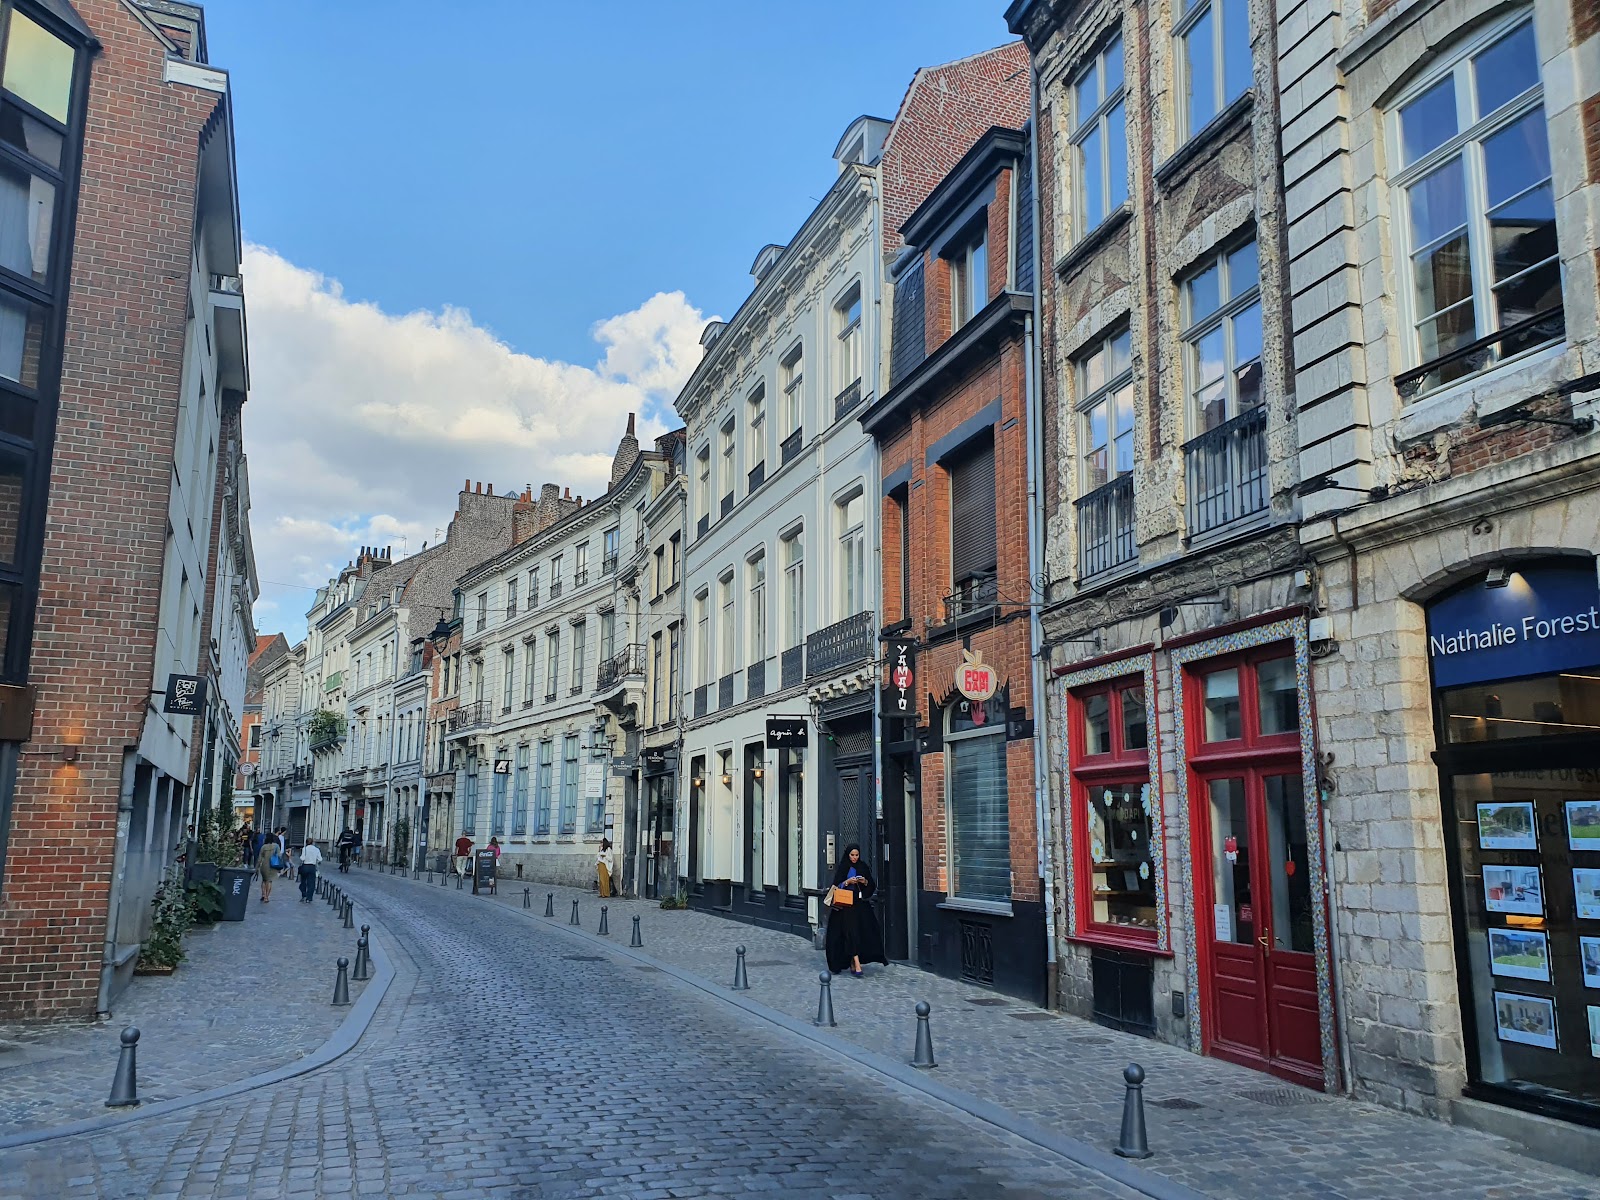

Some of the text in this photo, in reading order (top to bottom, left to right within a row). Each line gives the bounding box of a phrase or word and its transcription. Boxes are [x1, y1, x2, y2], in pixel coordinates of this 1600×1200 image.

[1430, 606, 1600, 656] Nathalie Forest
[896, 645, 909, 711] YAMATO
[964, 669, 989, 682] POM
